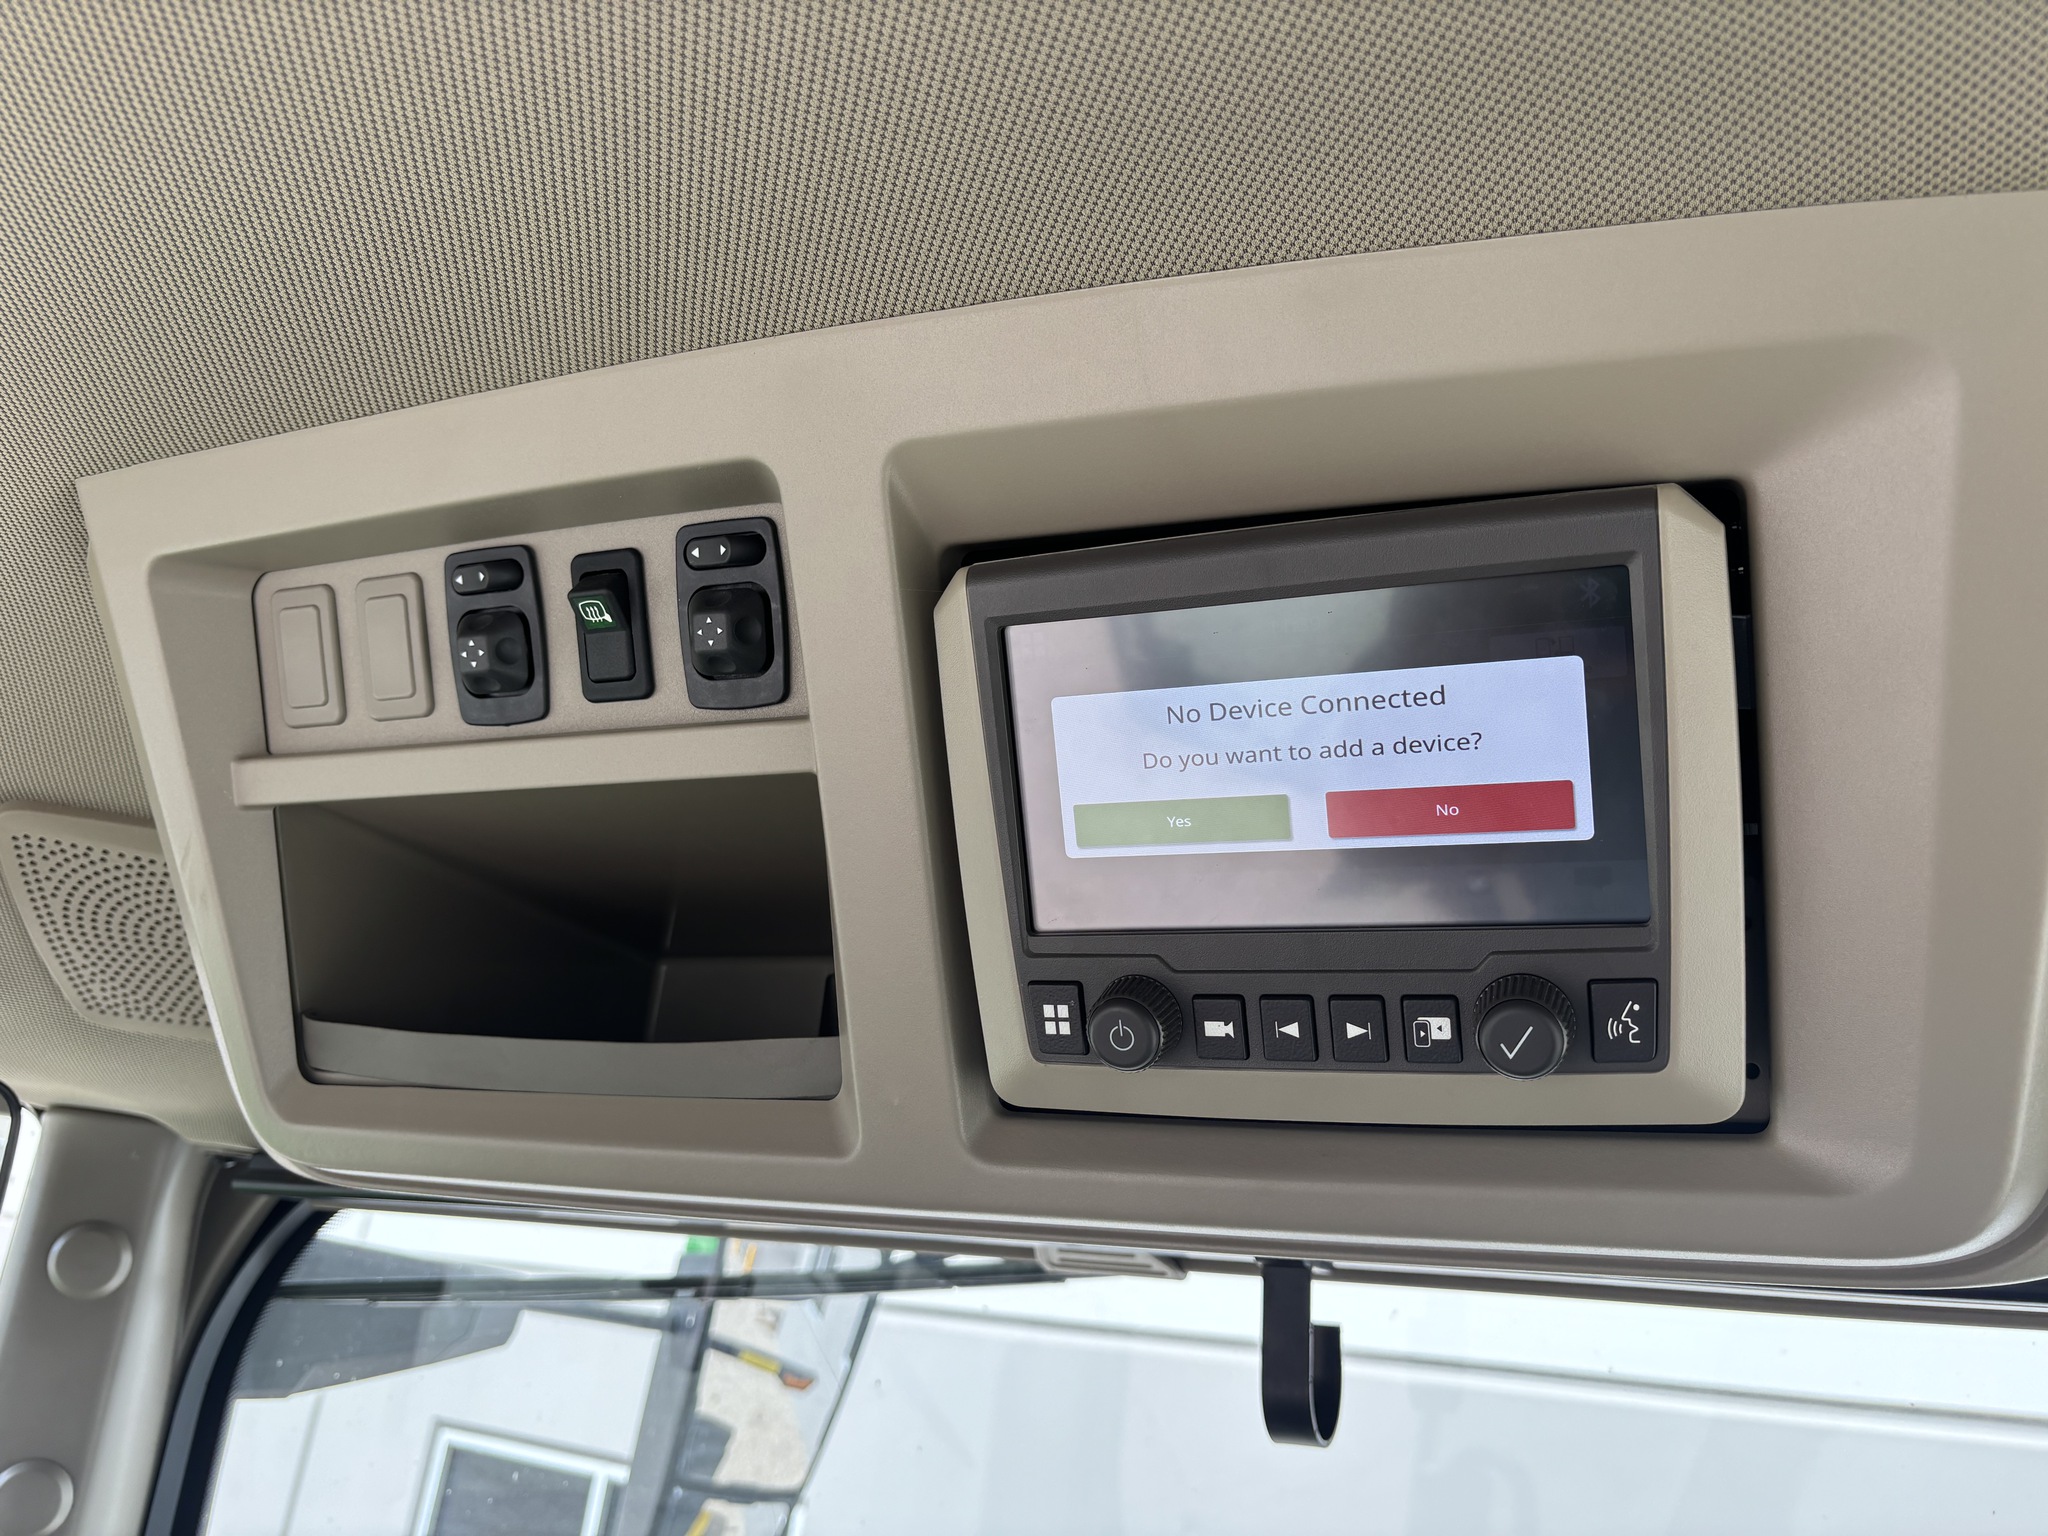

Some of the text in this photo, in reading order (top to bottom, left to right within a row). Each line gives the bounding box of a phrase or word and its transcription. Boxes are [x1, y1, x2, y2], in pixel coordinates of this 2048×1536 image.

[1167, 684, 1447, 724] No Device Connected
[1143, 732, 1483, 772] Do you want to add a device?
[1167, 816, 1192, 829] Yes
[1437, 804, 1460, 817] No
